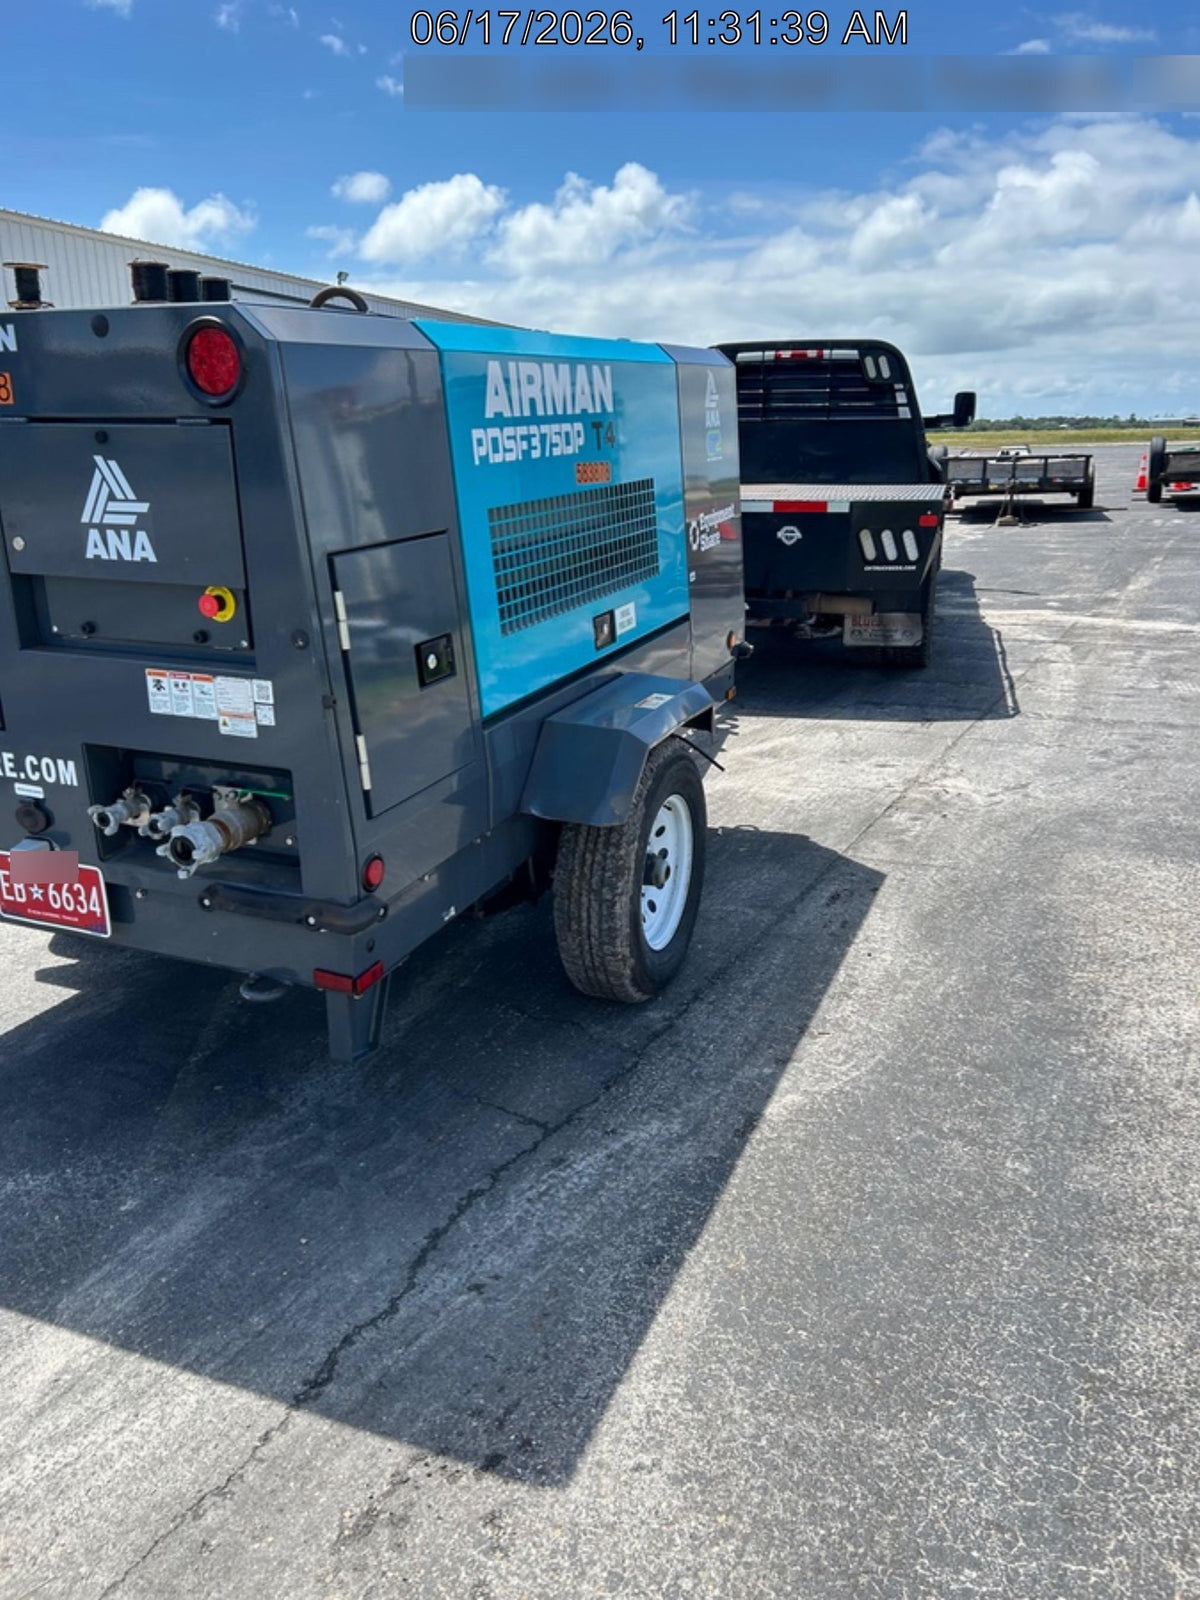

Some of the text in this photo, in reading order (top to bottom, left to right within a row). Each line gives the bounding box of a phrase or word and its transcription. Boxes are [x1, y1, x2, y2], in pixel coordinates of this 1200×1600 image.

[485, 360, 614, 418] AIRMAN
[471, 421, 616, 465] PDSF375DP T4
[85, 527, 158, 562] ANA
[0, 751, 78, 787] E.COM
